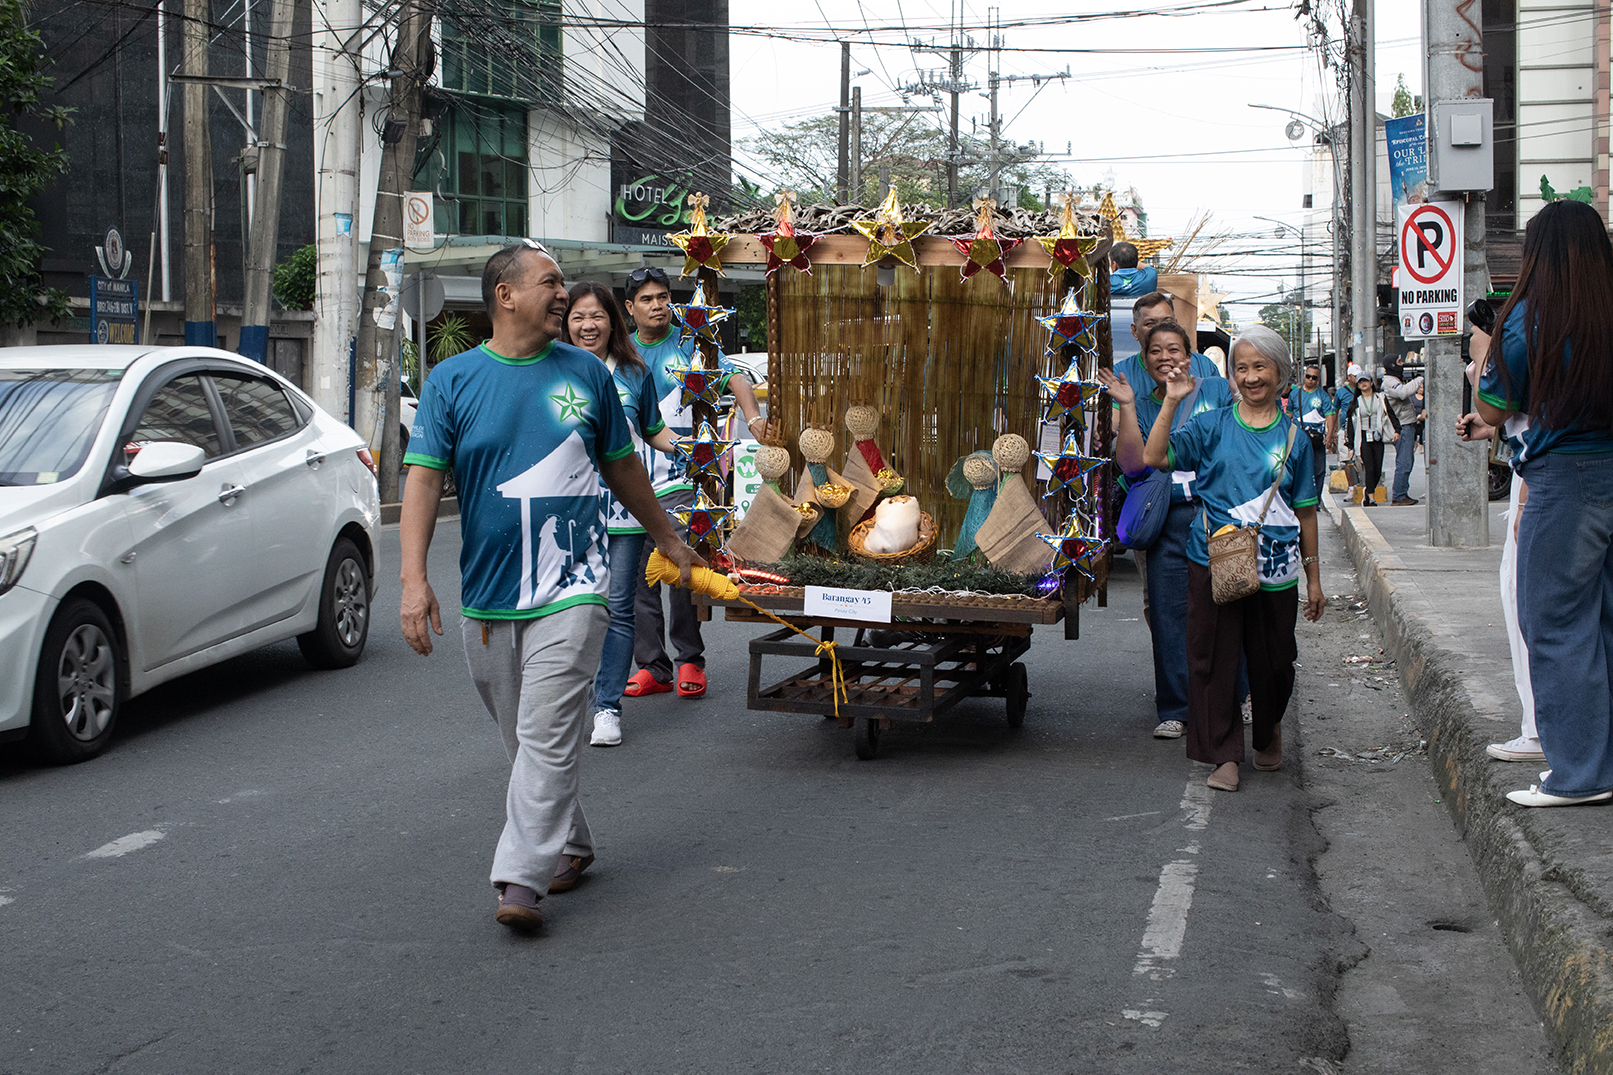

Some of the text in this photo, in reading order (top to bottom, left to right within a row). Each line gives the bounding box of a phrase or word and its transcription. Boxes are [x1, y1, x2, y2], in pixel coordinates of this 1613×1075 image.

[1393, 147, 1415, 159] OUR
[621, 184, 668, 204] HOTEL
[408, 222, 414, 230] NO
[407, 229, 430, 238] PARKING
[113, 282, 130, 293] MANILA
[1402, 288, 1458, 304] NO PARKING
[109, 322, 135, 344] WELCOME
[822, 593, 860, 604] Barangay
